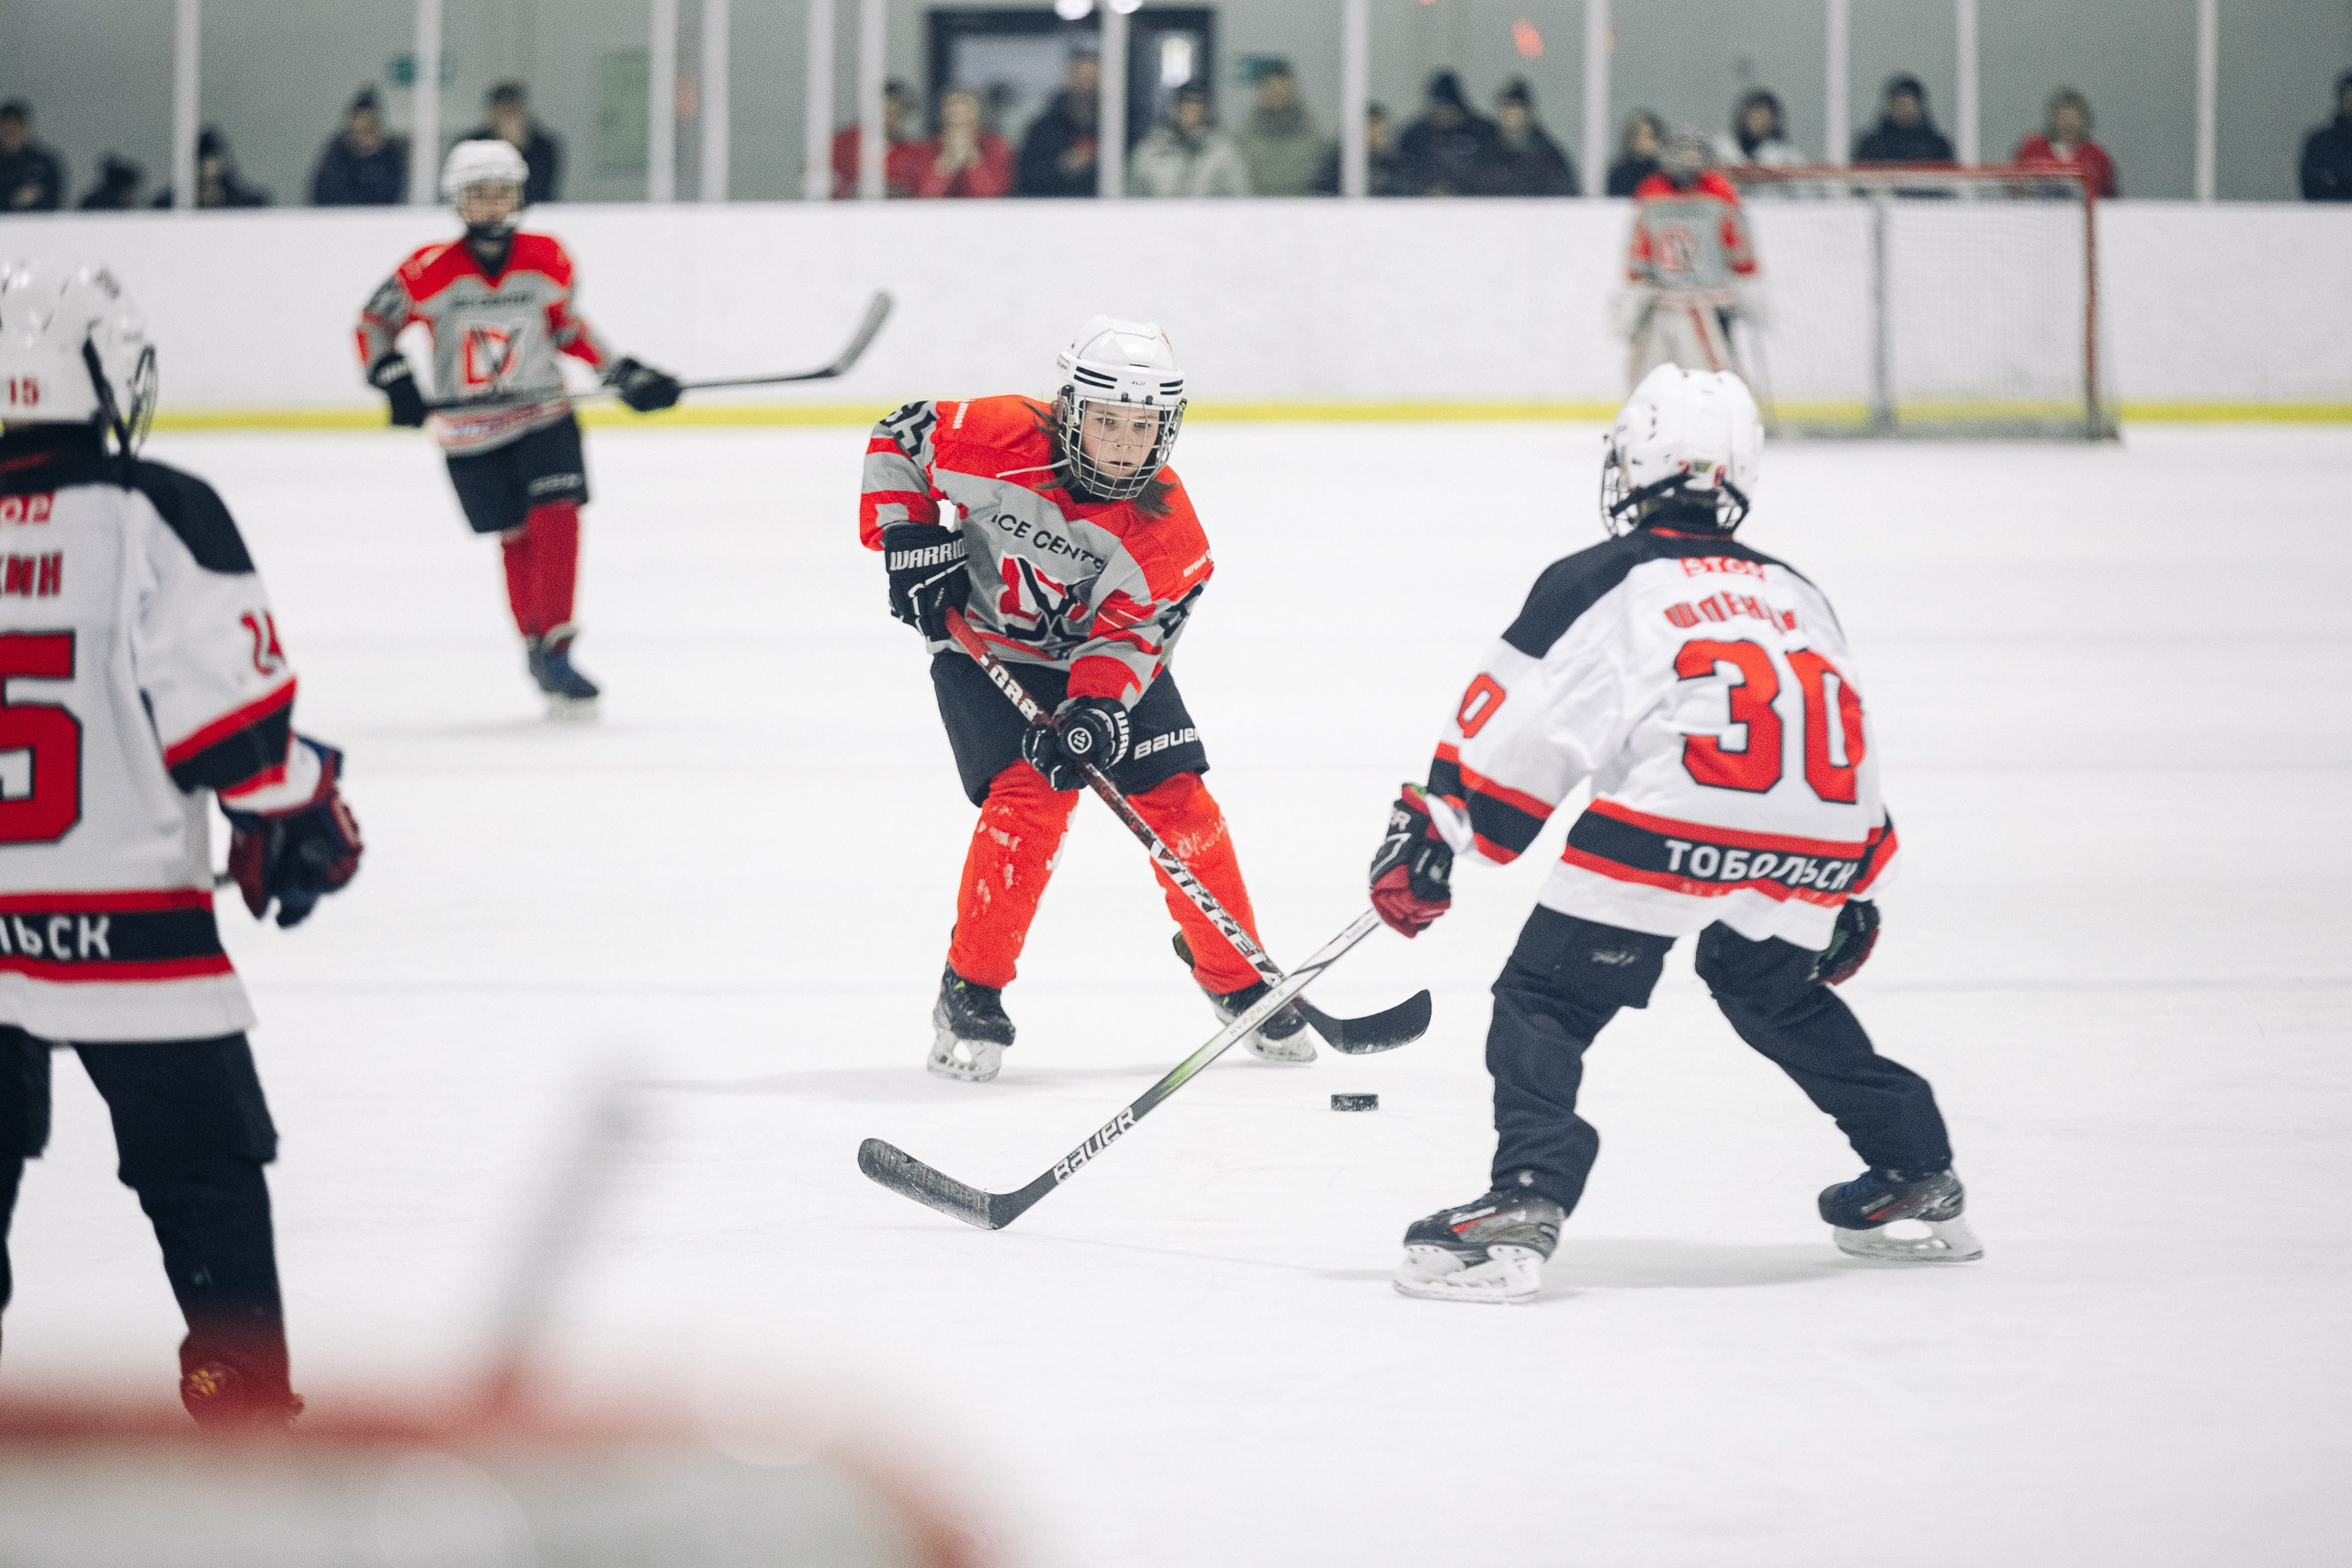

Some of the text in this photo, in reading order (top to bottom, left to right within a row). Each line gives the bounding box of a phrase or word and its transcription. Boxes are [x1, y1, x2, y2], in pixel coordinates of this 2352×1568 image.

[9, 375, 40, 408] 15
[990, 509, 1032, 539] ICE
[0, 550, 63, 599] ИН
[889, 538, 967, 571] WARRIO
[1672, 639, 1866, 805] 30
[1665, 839, 1860, 891] ТОБОЛЬСК
[1053, 1104, 1137, 1185] BAUER
